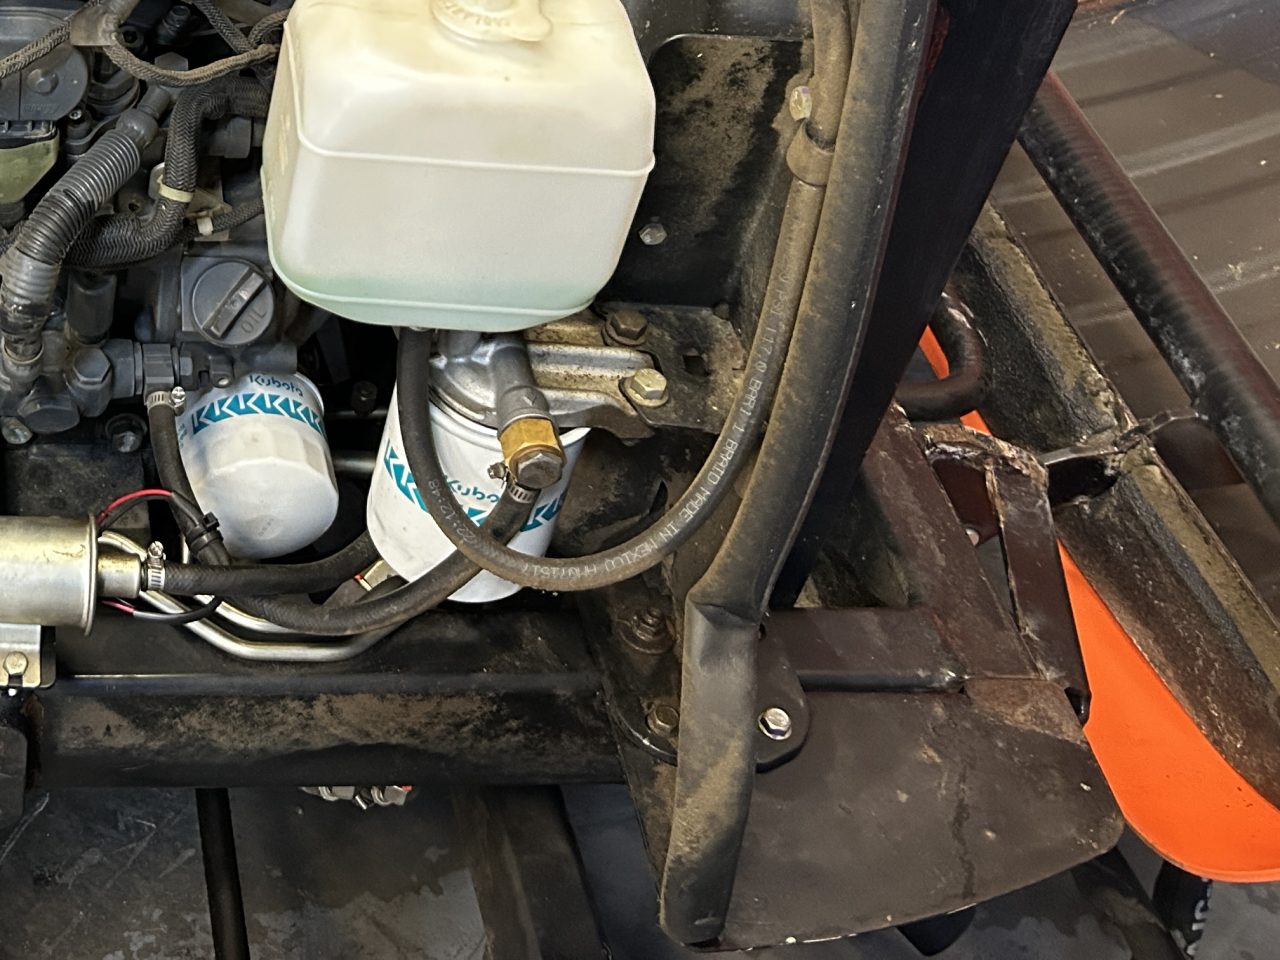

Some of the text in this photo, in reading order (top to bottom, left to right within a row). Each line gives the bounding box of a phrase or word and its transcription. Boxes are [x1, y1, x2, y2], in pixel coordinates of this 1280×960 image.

[240, 310, 267, 334] OIL
[249, 374, 304, 397] Kubota
[708, 440, 738, 484] BRAID
[444, 474, 500, 503] Kubo
[428, 479, 475, 541] 22:12:48
[683, 488, 713, 523] MADE
[659, 524, 681, 542] IN
[604, 538, 659, 572] MEXICO
